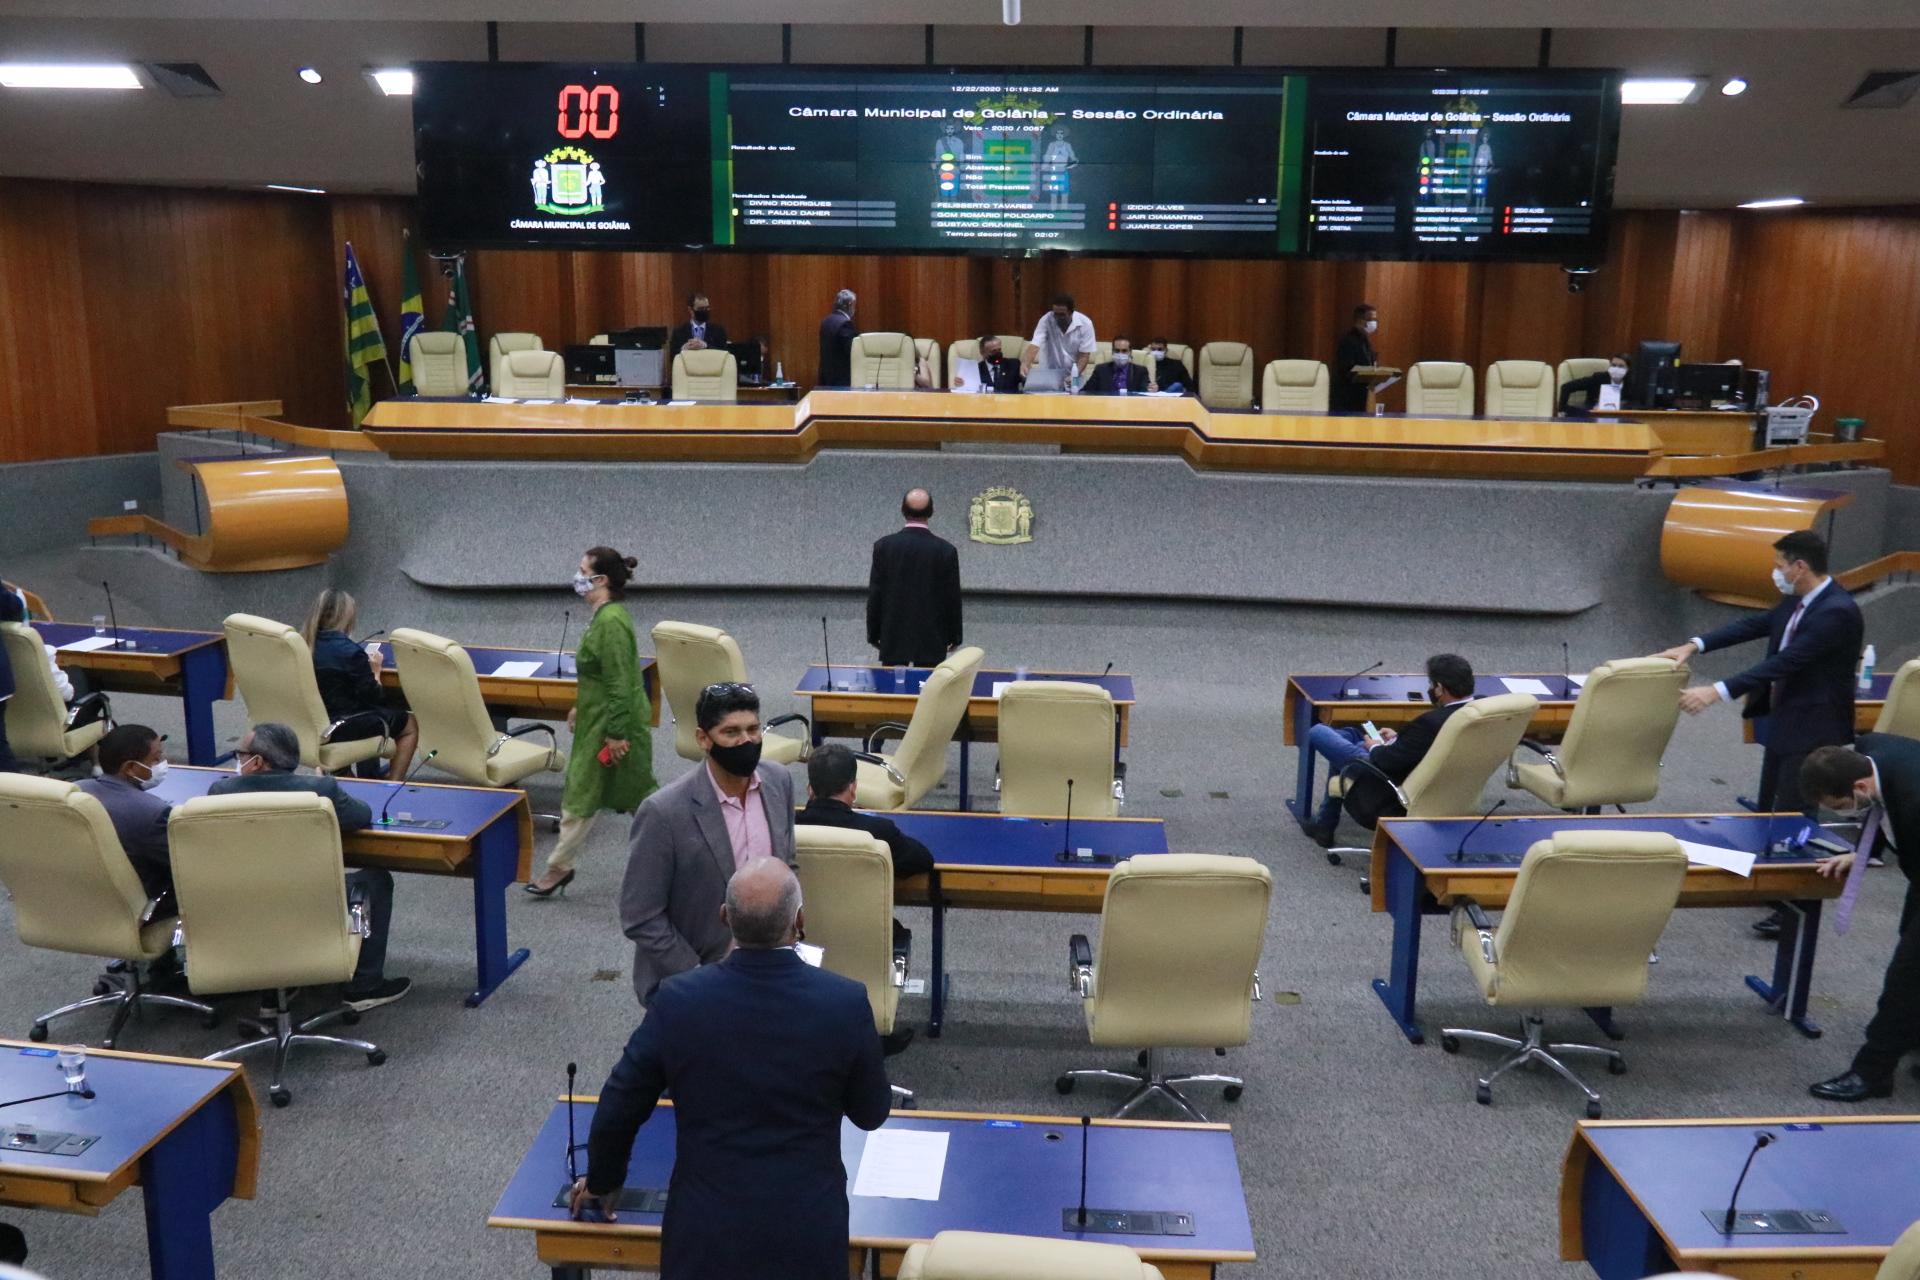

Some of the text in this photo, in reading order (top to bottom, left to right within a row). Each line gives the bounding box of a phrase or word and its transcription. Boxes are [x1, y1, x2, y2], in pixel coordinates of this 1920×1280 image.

[558, 85, 619, 139] 00
[788, 107, 858, 117] Câmara
[864, 108, 946, 118] Municipal
[952, 108, 975, 118] de
[981, 108, 1048, 118] Goiânia
[1072, 109, 1136, 120] Sessão
[1142, 110, 1224, 120] Ordinária
[1346, 112, 1383, 120] Câmara
[1385, 112, 1428, 122] Municipal
[1430, 112, 1444, 121] de
[1445, 112, 1481, 122] Goiânia
[1492, 112, 1526, 122] Sessão
[1528, 112, 1570, 122] Ordinária
[510, 219, 630, 230] CÂMARA MUNICIPAL DE GOIÂNIA
